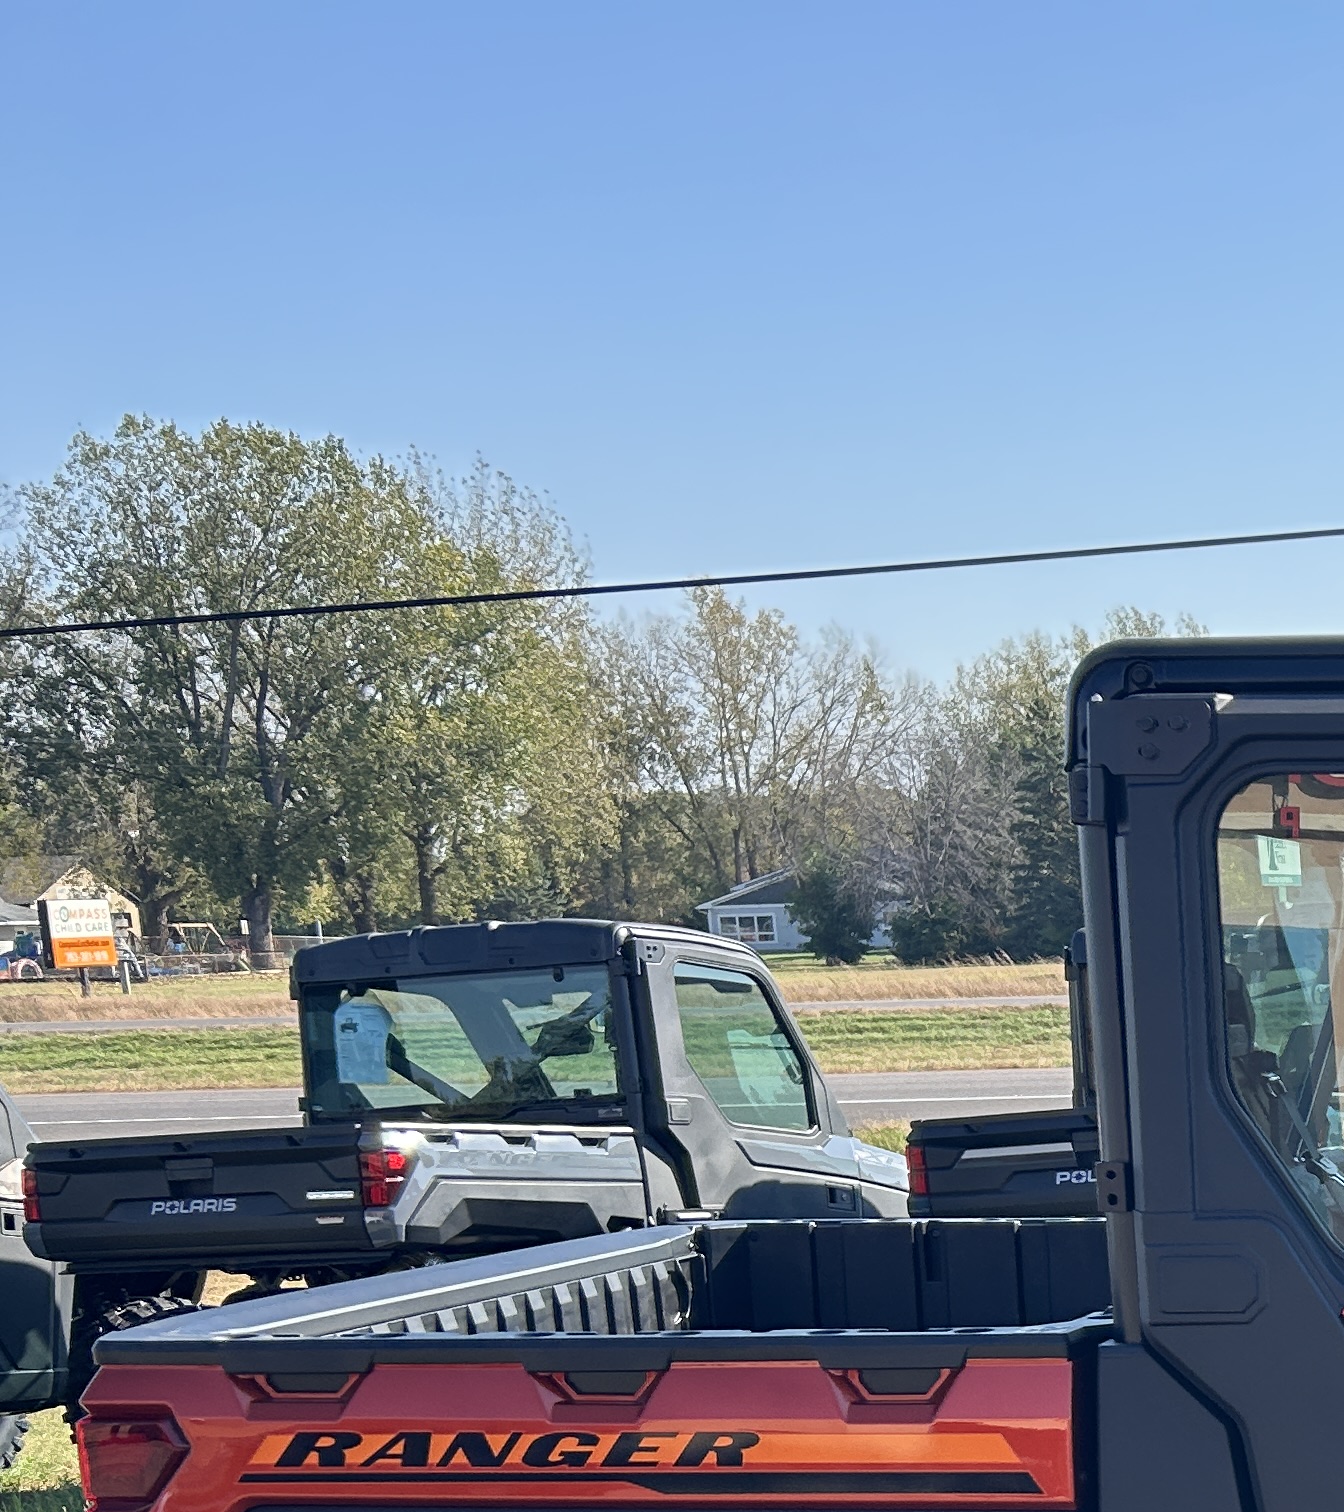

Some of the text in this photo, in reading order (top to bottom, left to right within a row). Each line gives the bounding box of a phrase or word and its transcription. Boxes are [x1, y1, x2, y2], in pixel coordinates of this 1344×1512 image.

[53, 906, 108, 922] COMPASS
[55, 922, 109, 933] CHILD CARE
[151, 1198, 237, 1216] POLARIS
[274, 1431, 760, 1468] RANGER
